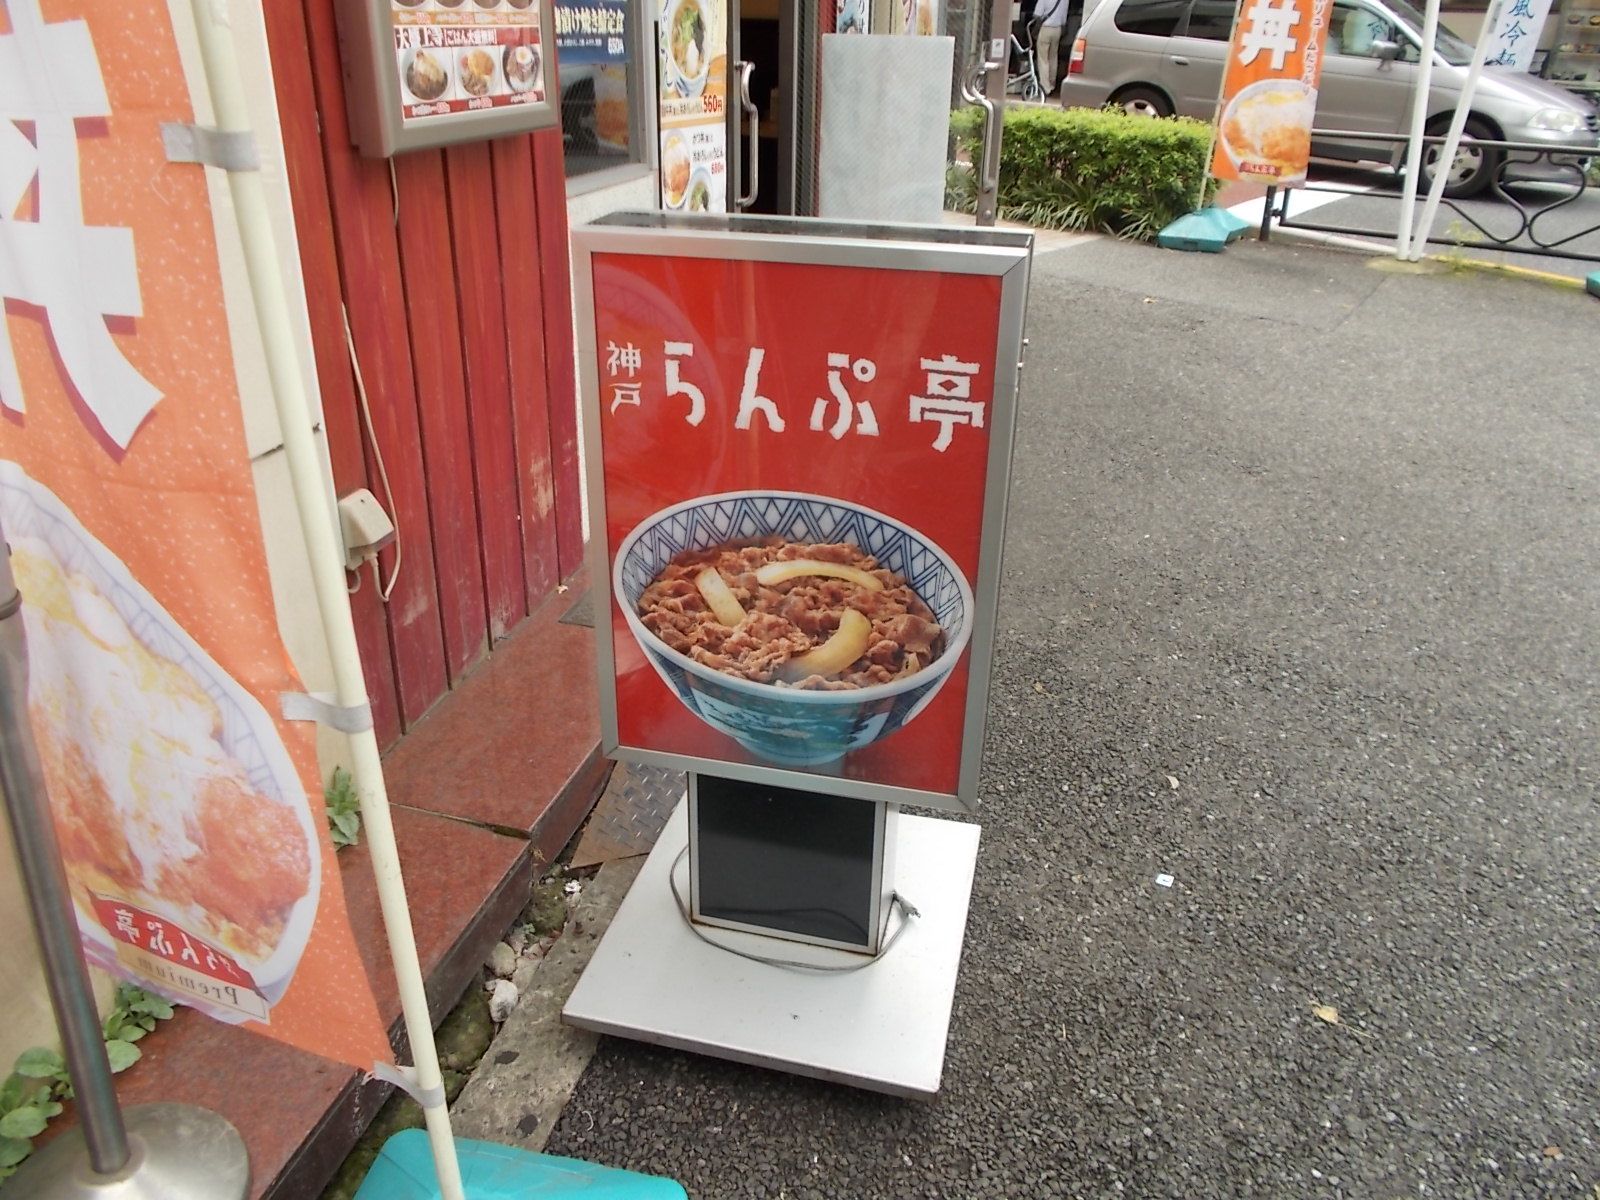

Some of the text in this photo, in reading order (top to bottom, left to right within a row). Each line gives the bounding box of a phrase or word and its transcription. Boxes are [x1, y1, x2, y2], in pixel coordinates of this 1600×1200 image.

[606, 340, 985, 453] 神戸 らんぷ亭
